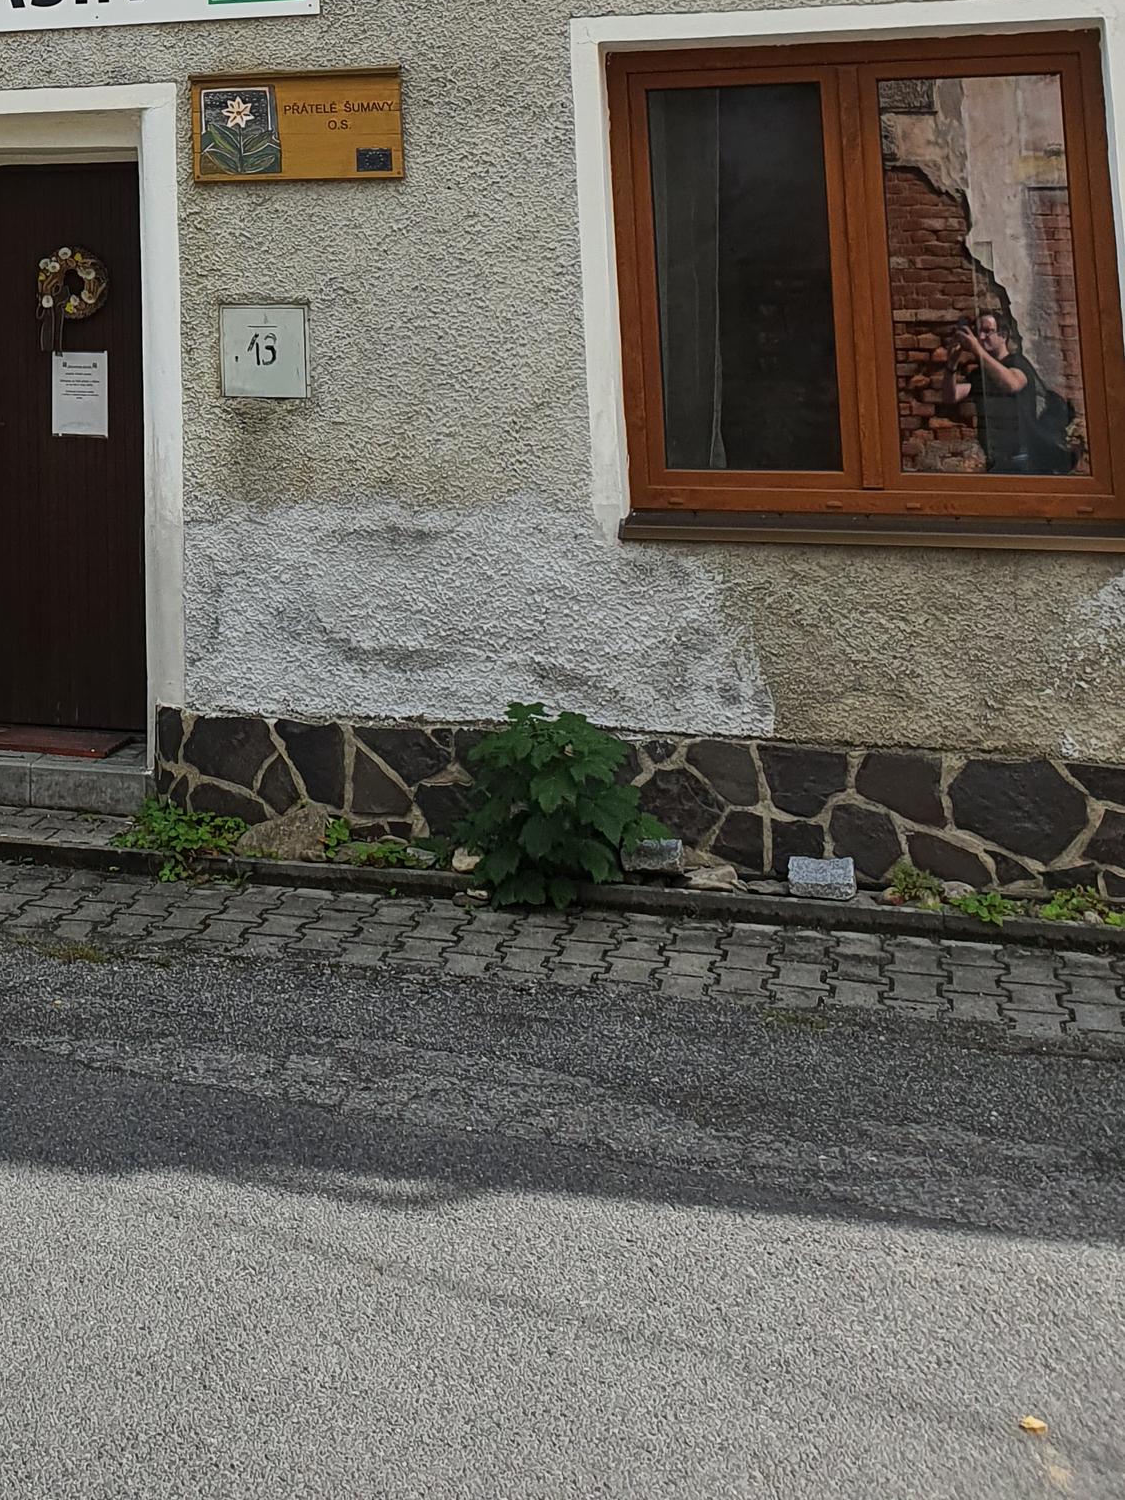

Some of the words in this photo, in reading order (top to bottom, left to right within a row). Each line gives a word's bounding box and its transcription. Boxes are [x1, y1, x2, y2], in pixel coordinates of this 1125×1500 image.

[343, 99, 394, 113] ŠUMAVY
[327, 119, 352, 131] O.S.
[247, 332, 277, 366] 13
